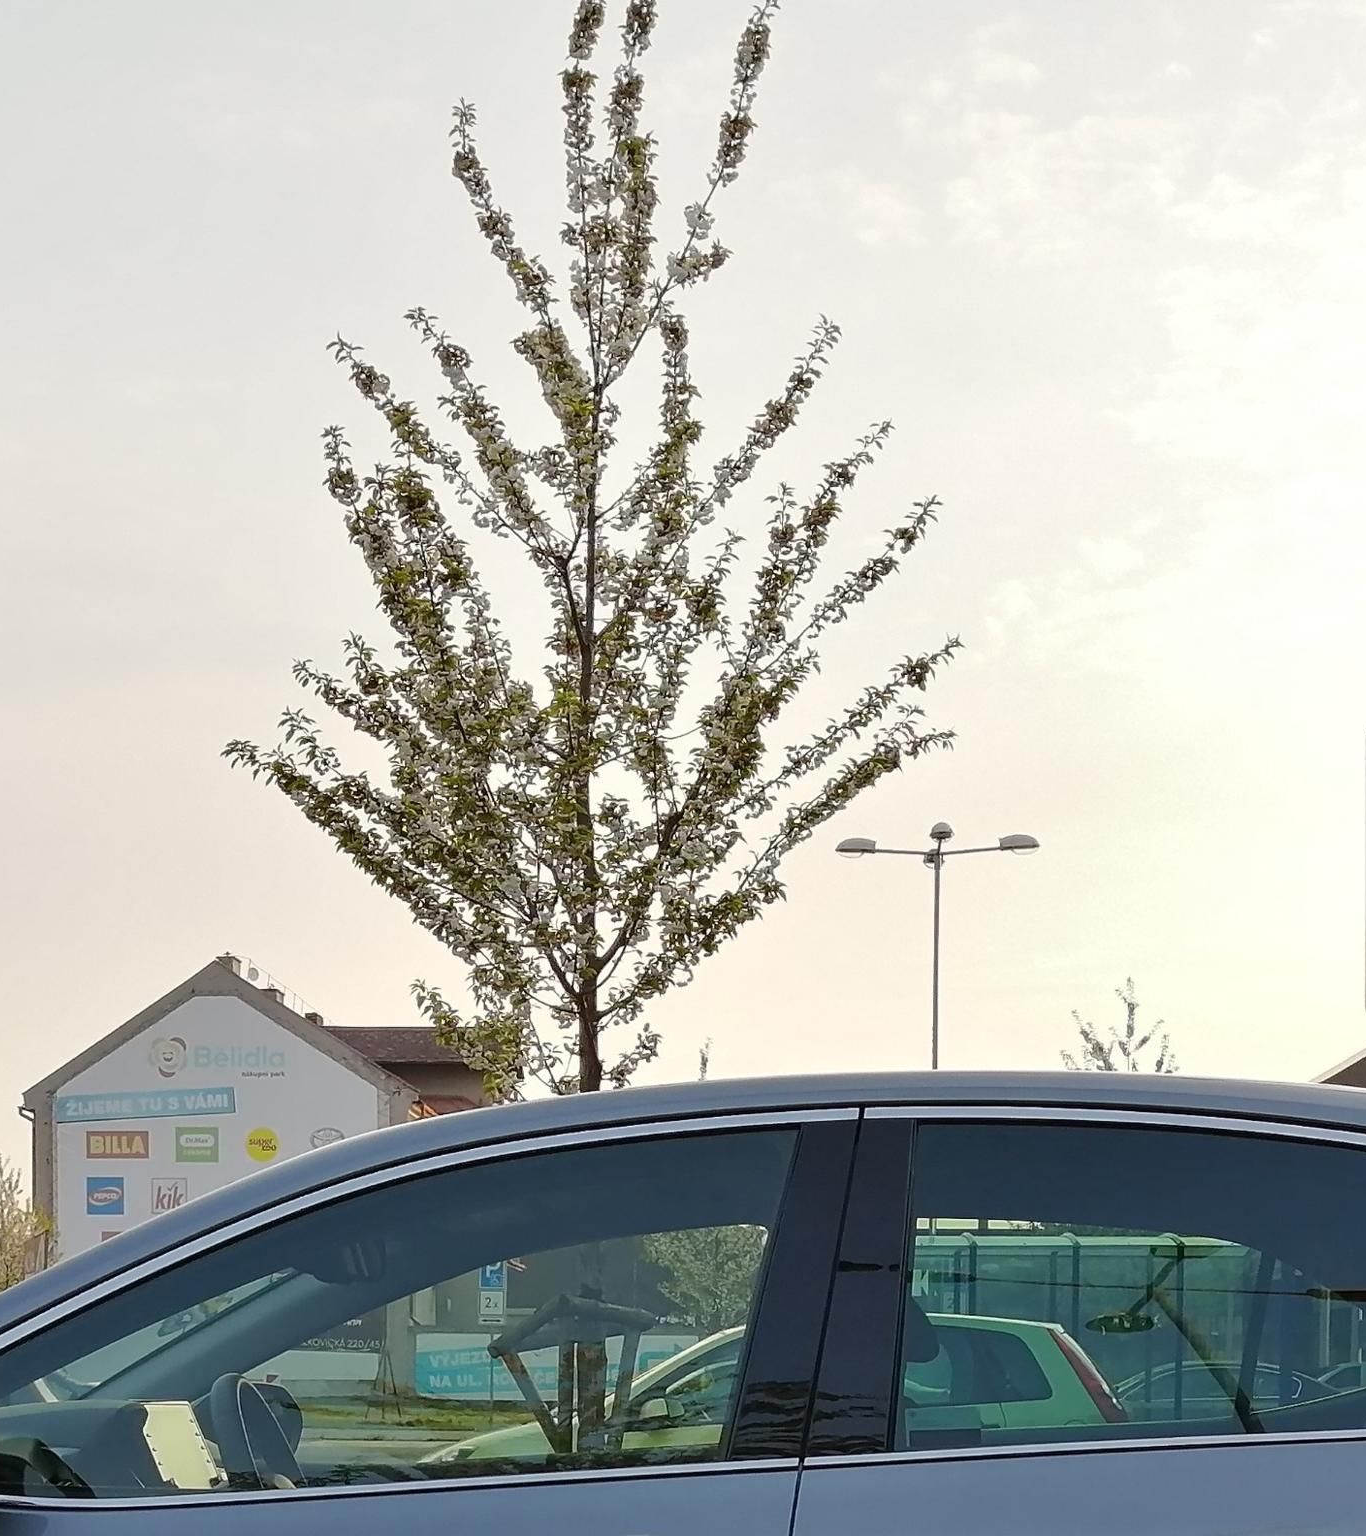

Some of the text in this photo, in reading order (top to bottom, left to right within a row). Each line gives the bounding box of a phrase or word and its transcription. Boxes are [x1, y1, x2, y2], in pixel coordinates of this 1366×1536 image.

[66, 1093, 228, 1116] ŽIJEME TU S VÁMI
[90, 1135, 146, 1154] BILLA
[248, 1137, 274, 1148] super
[93, 1192, 117, 1201] PEPCO
[430, 1374, 452, 1388] NA
[456, 1373, 482, 1387] UL.
